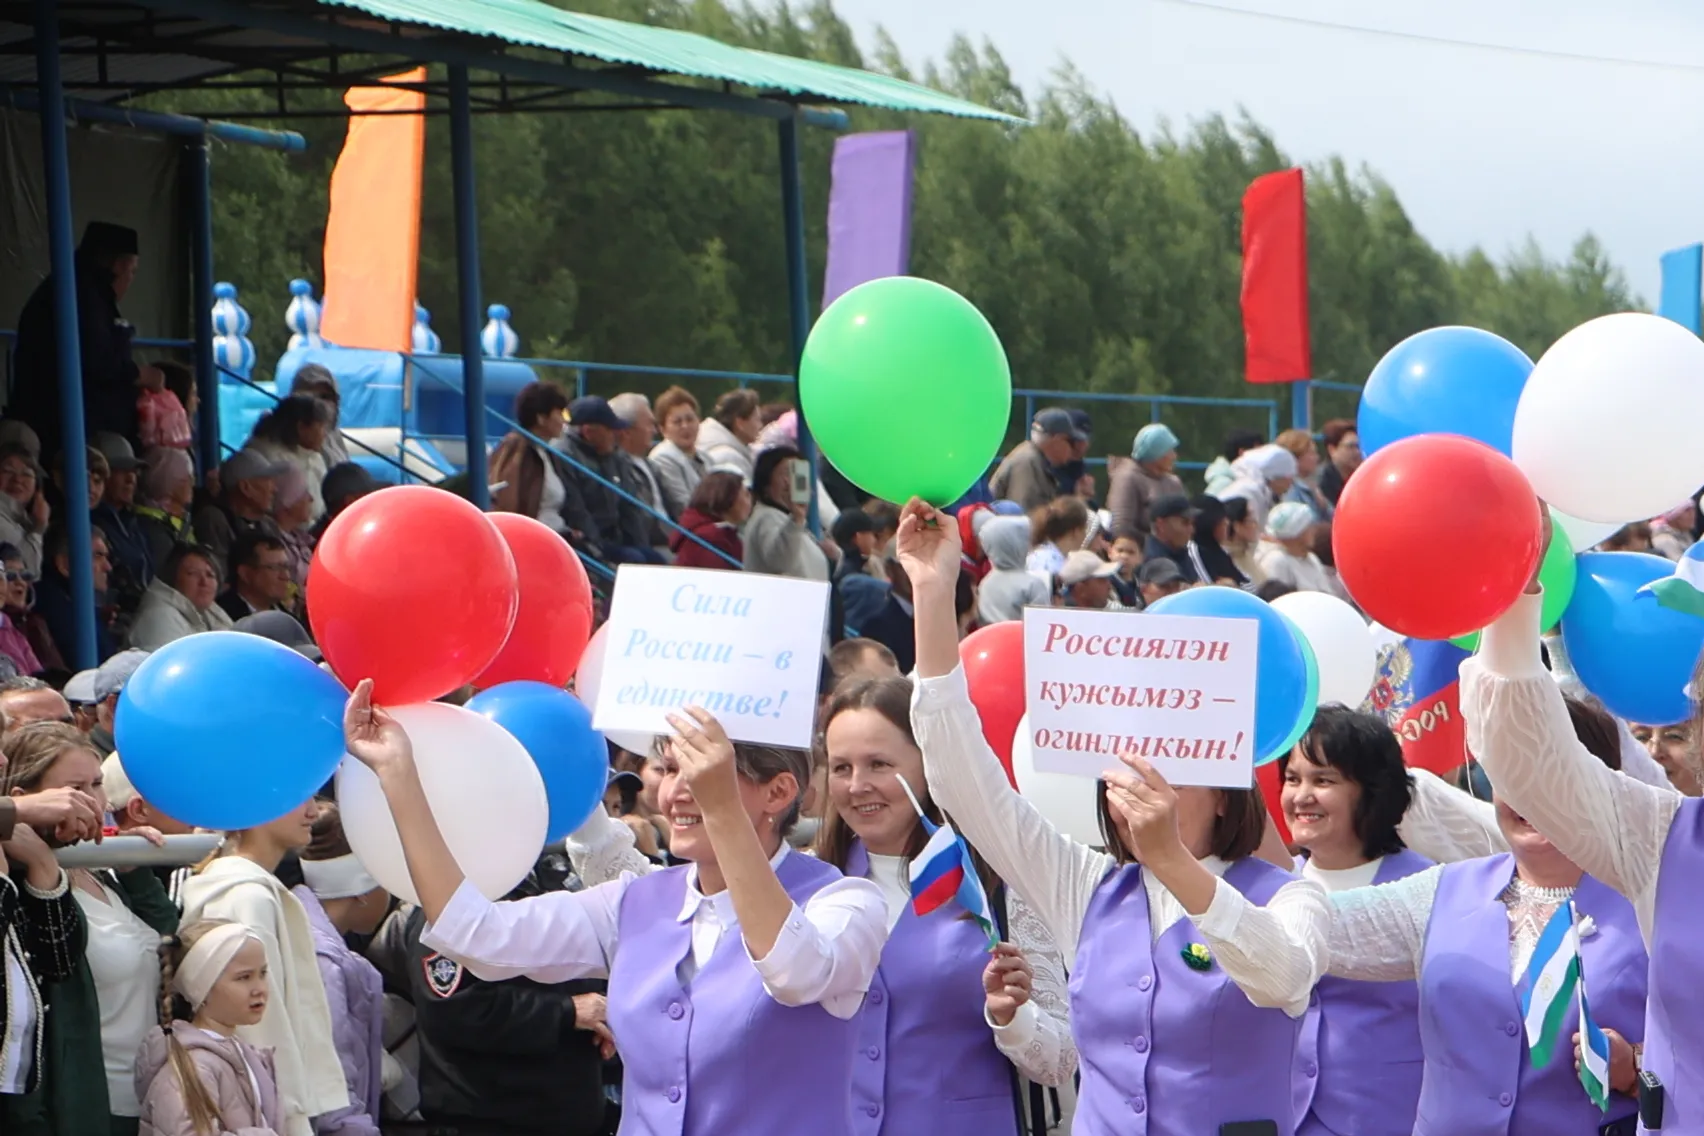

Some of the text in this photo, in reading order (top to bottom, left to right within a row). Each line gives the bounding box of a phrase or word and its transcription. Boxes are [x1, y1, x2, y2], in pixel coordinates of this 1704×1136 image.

[671, 583, 753, 618] Сила
[623, 628, 733, 664] России
[774, 650, 794, 671] в
[1042, 623, 1231, 662] Россиялэн
[616, 677, 789, 719] единстве!
[1039, 680, 1203, 711] кужымэз
[1034, 727, 1244, 761] огинлыкын!
